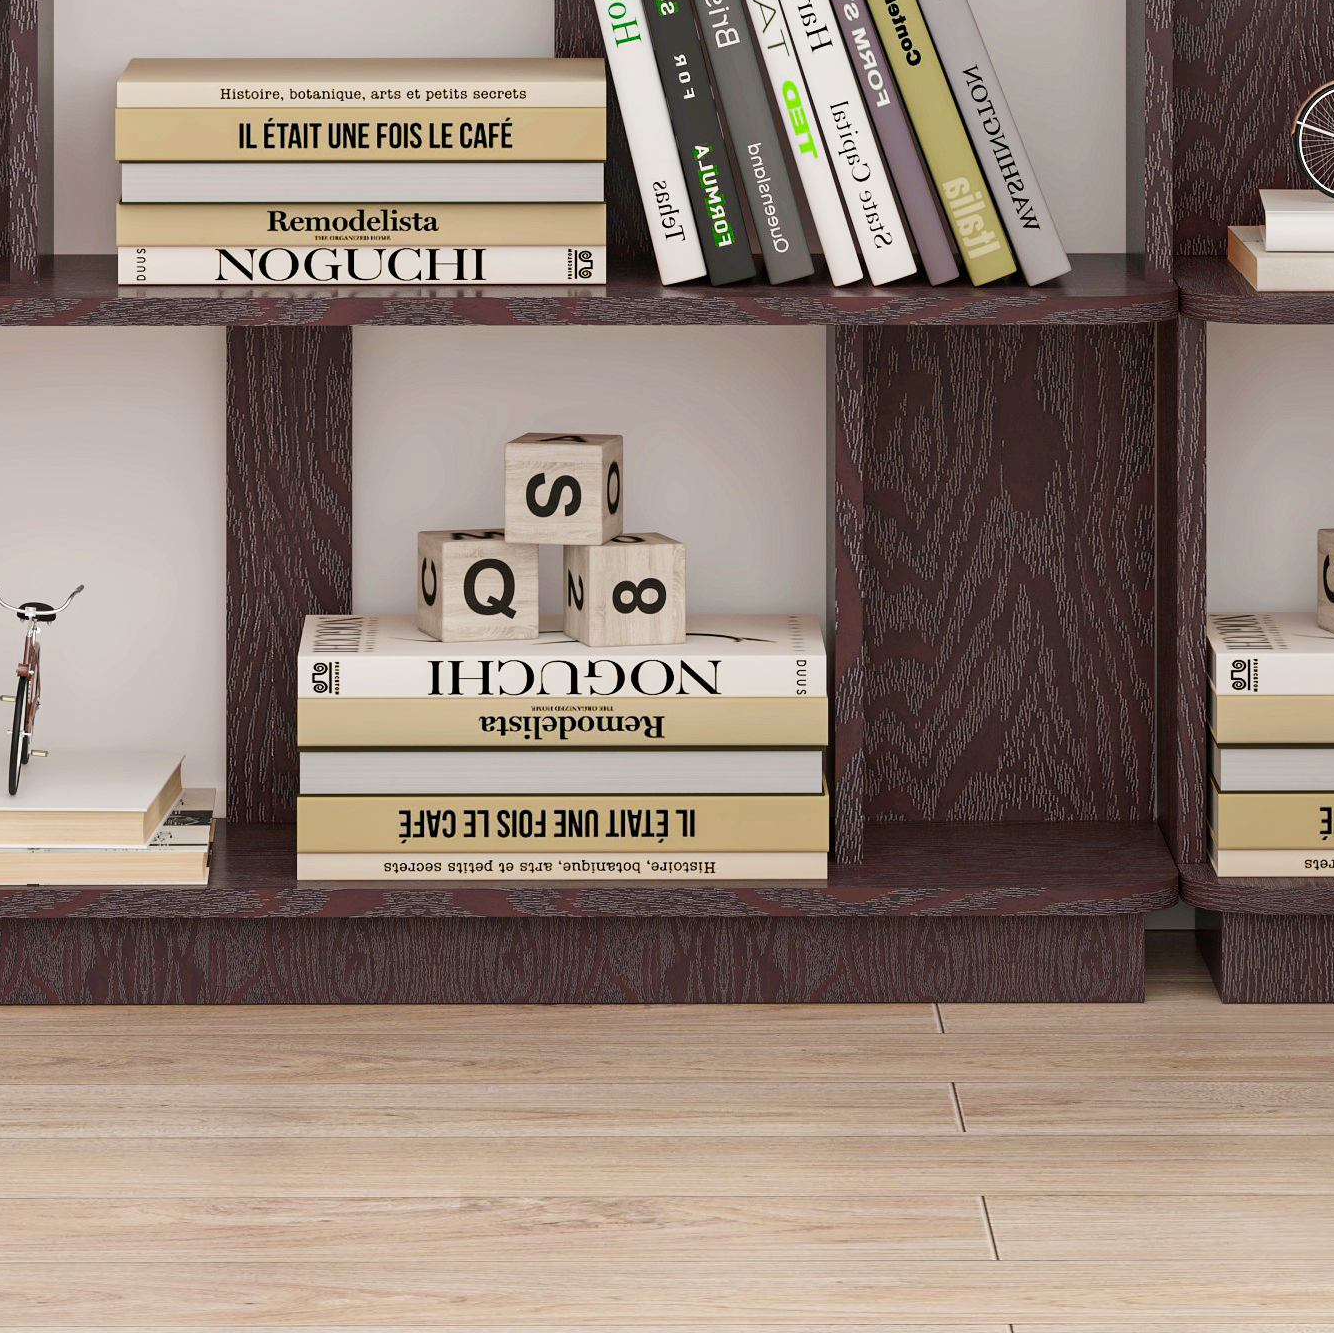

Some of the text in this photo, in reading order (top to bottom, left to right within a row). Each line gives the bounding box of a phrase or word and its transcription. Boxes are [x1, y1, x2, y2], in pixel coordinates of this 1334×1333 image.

[220, 88, 527, 102] Histoire, botanique, arts et petits secrets
[239, 116, 513, 149] IL ÉTAIT UNE FOIS LE CAFÉ
[266, 208, 440, 232] Remodelista
[136, 247, 147, 281] DUUS
[214, 247, 487, 282] NOGUCHI
[525, 472, 582, 518] S
[463, 558, 517, 620] Q
[612, 577, 667, 616] 8
[427, 659, 722, 696] NOGUCHI
[478, 715, 666, 740] Remodelista
